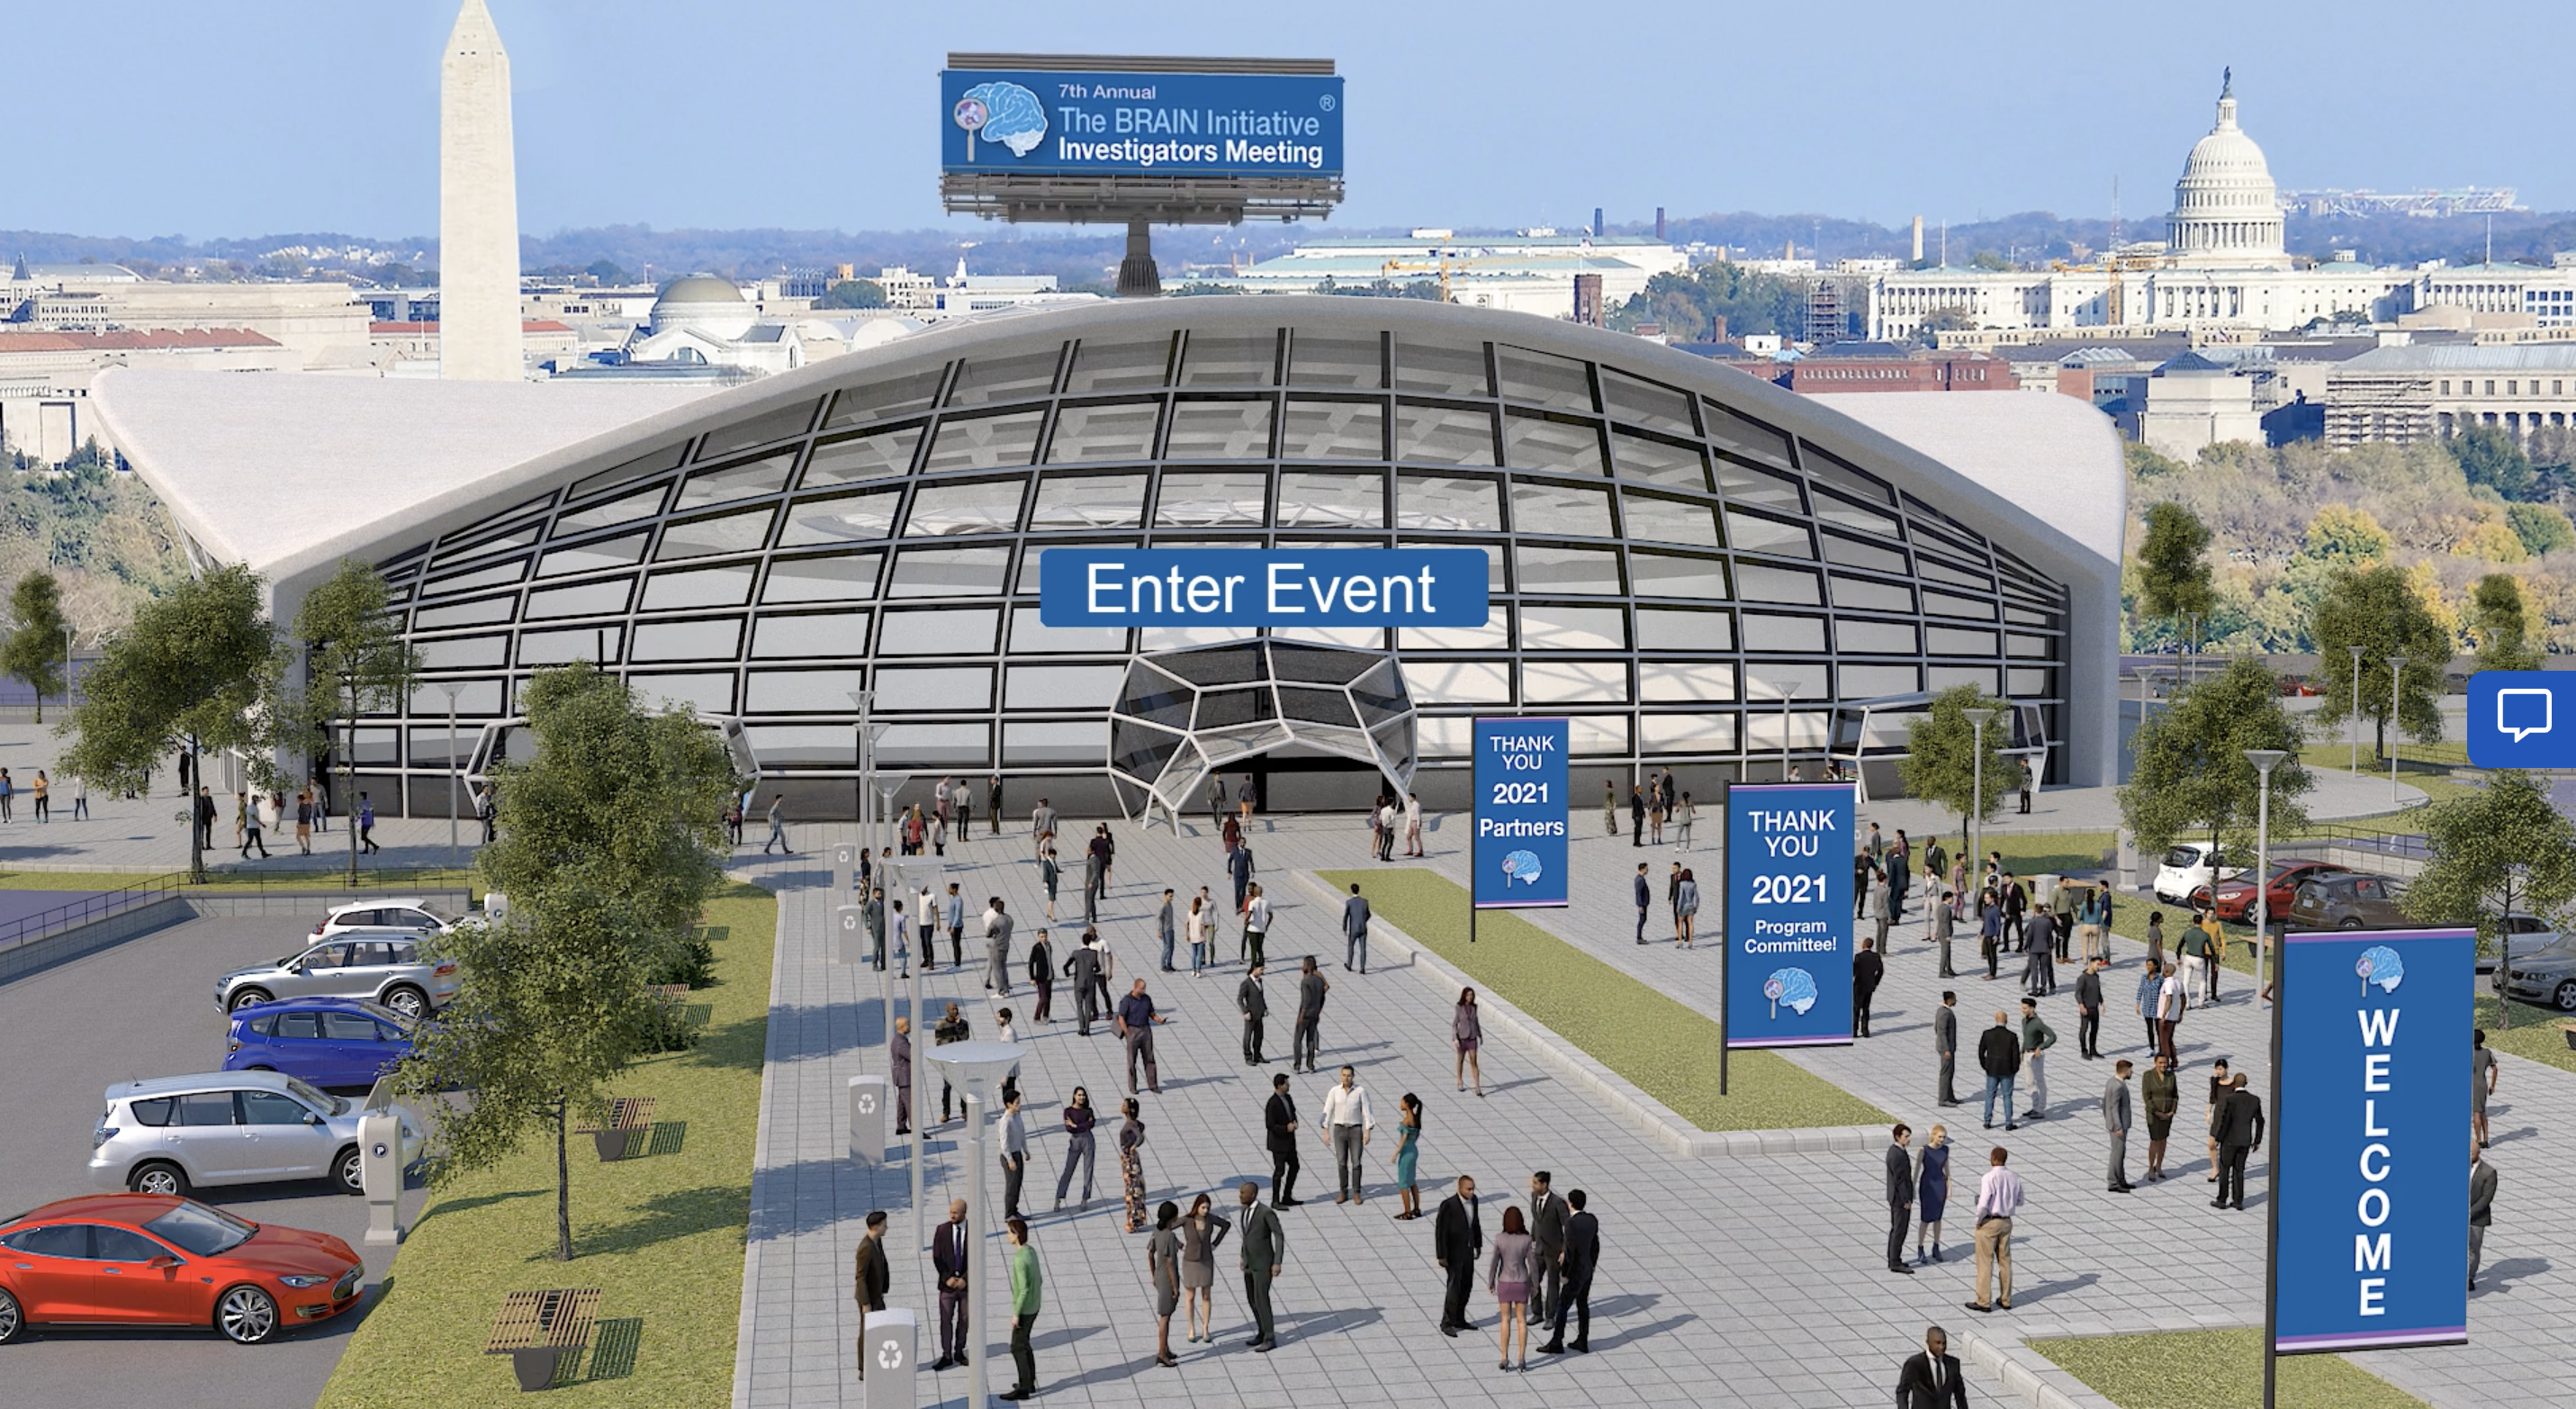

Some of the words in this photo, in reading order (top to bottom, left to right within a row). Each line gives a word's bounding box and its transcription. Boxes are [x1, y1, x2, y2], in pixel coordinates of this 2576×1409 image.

[1059, 85, 1086, 97] 7th
[1094, 86, 1155, 99] Annual
[1058, 107, 1106, 132] The
[1116, 108, 1197, 133] BRAIN
[1208, 108, 1320, 136] Initiative
[1060, 137, 1217, 166] Investigators
[1226, 140, 1322, 168] Meeting
[1491, 736, 1554, 751] THANK
[1502, 754, 1541, 770] YOU
[1493, 782, 1547, 804] 2021
[1481, 818, 1563, 836] Partners
[1749, 810, 1834, 832] THANK
[1764, 835, 1818, 857] YOU
[1752, 875, 1825, 903] 2021
[1756, 920, 1826, 936] Program
[1745, 936, 1837, 953] Committee!
[2355, 1009, 2400, 1315] WELCOME
